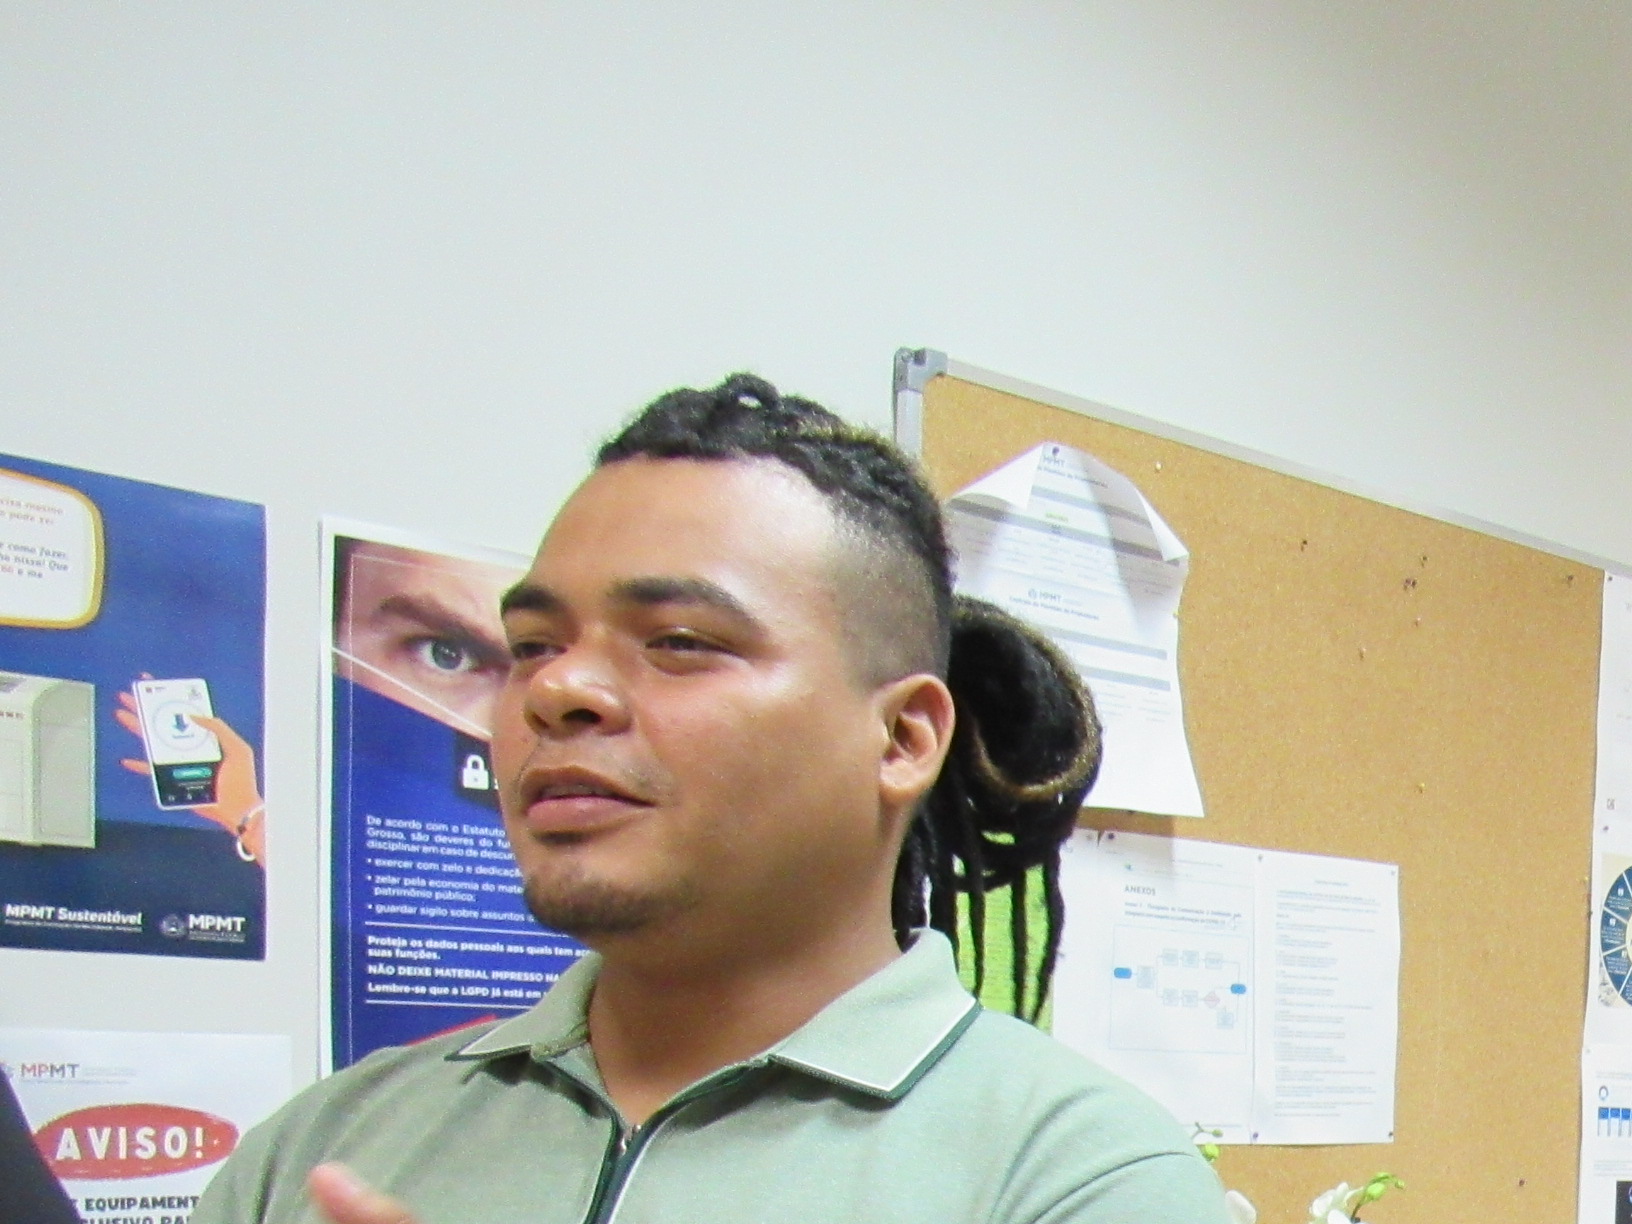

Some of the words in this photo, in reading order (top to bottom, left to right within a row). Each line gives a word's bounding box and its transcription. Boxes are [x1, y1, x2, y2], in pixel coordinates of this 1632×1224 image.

[366, 815, 382, 826] De
[385, 818, 422, 830] acordo
[425, 822, 449, 832] com
[463, 824, 507, 839] Estatuto
[366, 839, 420, 853] disciplinar
[421, 845, 439, 855] em
[440, 846, 464, 857] caso
[465, 848, 478, 858] de
[410, 831, 430, 843] são
[434, 833, 475, 847] deveres
[478, 837, 494, 848] do
[374, 858, 414, 869] exercer
[416, 861, 440, 871] com
[442, 863, 464, 873] zelo
[374, 873, 400, 885] zelar
[403, 876, 427, 888] pela
[428, 880, 479, 891] economia
[481, 882, 496, 892] do
[1125, 885, 1156, 896] ANEXOS
[374, 886, 433, 899] patrimônio
[5, 903, 56, 920] MPMT
[375, 903, 418, 914] guardar
[420, 906, 448, 918] sigilo
[450, 908, 479, 919] sobre
[481, 910, 525, 922] assuntos
[189, 913, 246, 932] MPMT
[367, 935, 408, 949] Proteja
[410, 939, 423, 948] os
[425, 938, 458, 950] dados
[460, 941, 504, 953] pessoais
[506, 944, 524, 954] aos
[526, 945, 553, 956] quais
[367, 948, 393, 958] suas
[395, 948, 441, 960] funções.
[367, 962, 396, 975] NÃO
[397, 965, 432, 977] DEIXE
[434, 966, 490, 980] MATERIAL
[491, 970, 544, 982] IMPRESSO
[367, 981, 427, 994] Lembre-se
[428, 986, 450, 996] que
[461, 986, 490, 997] LGPD
[491, 987, 501, 999] já
[503, 988, 524, 998] está
[525, 990, 541, 998] em
[21, 1062, 80, 1078] MPMT
[55, 1126, 205, 1160] AVISO!
